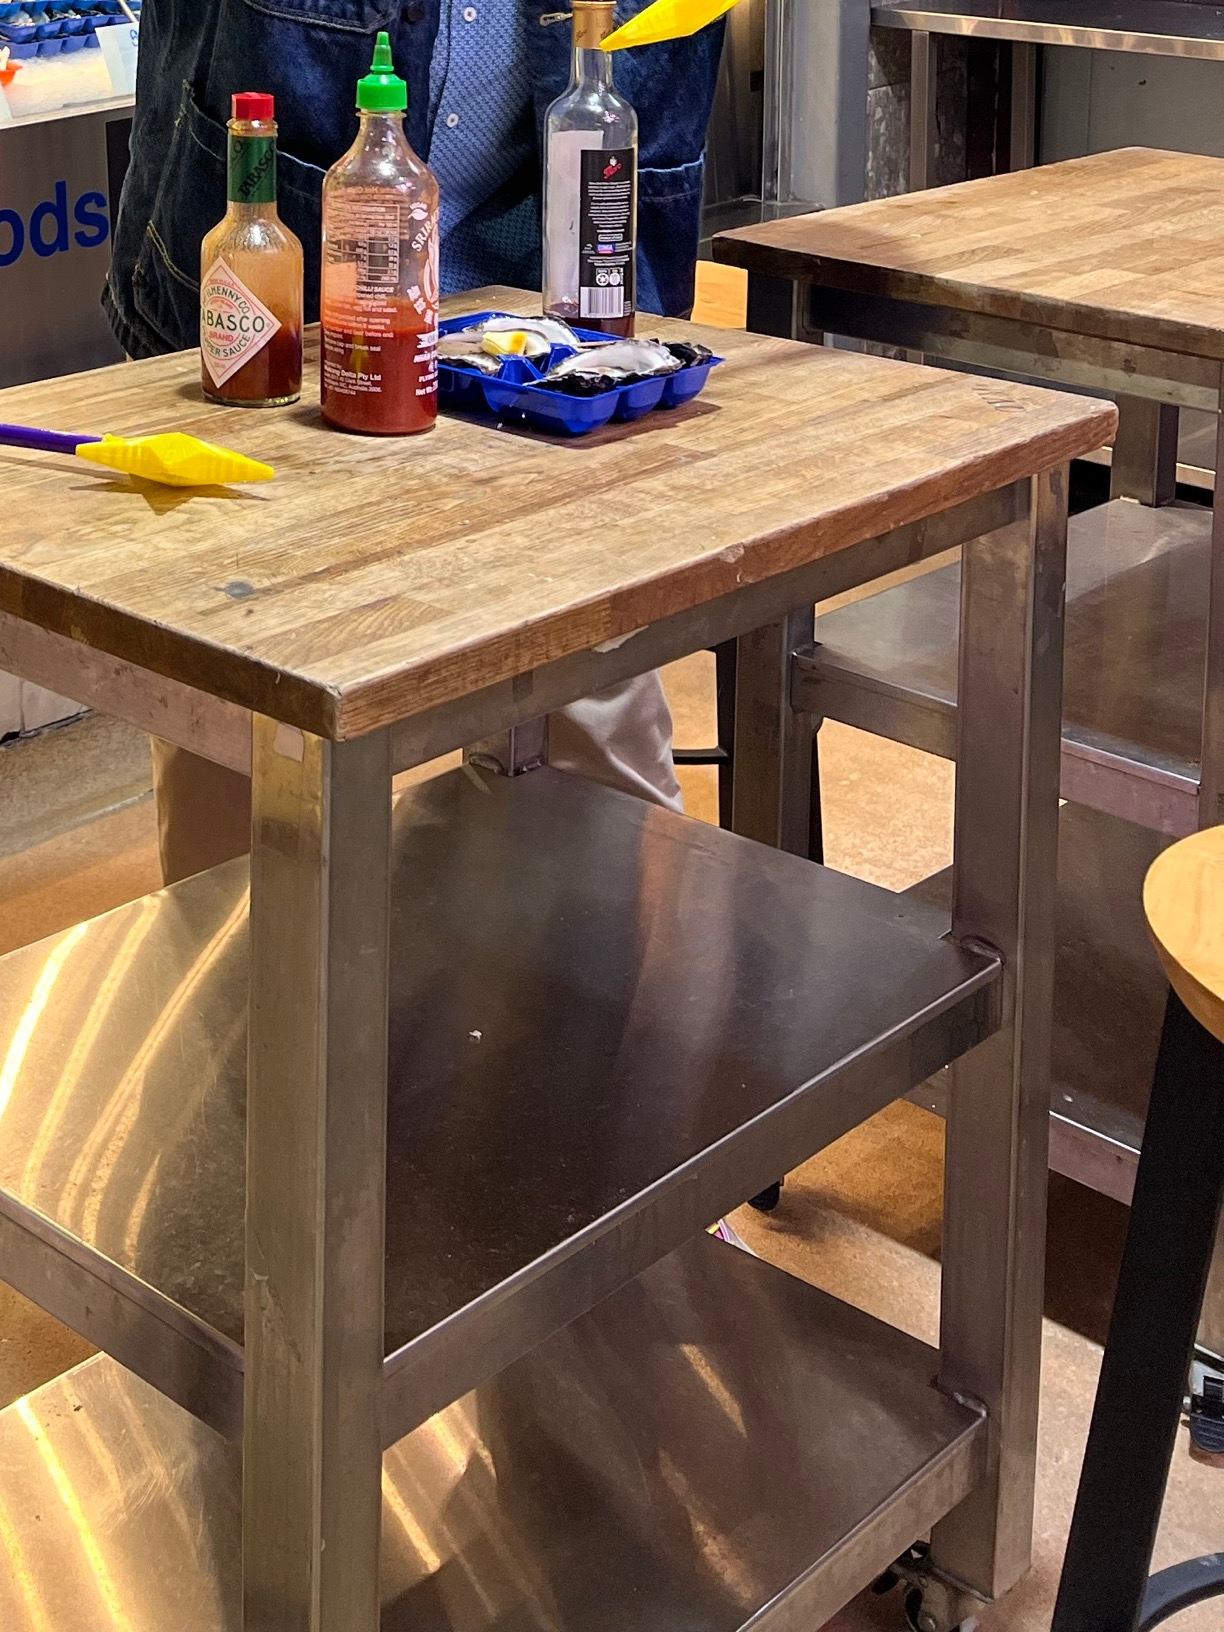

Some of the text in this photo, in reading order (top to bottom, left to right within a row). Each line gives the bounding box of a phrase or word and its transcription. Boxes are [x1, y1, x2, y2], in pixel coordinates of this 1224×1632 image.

[202, 307, 265, 333] ABASCO
[209, 330, 234, 342] BRAND
[223, 334, 250, 358] SAUCE
